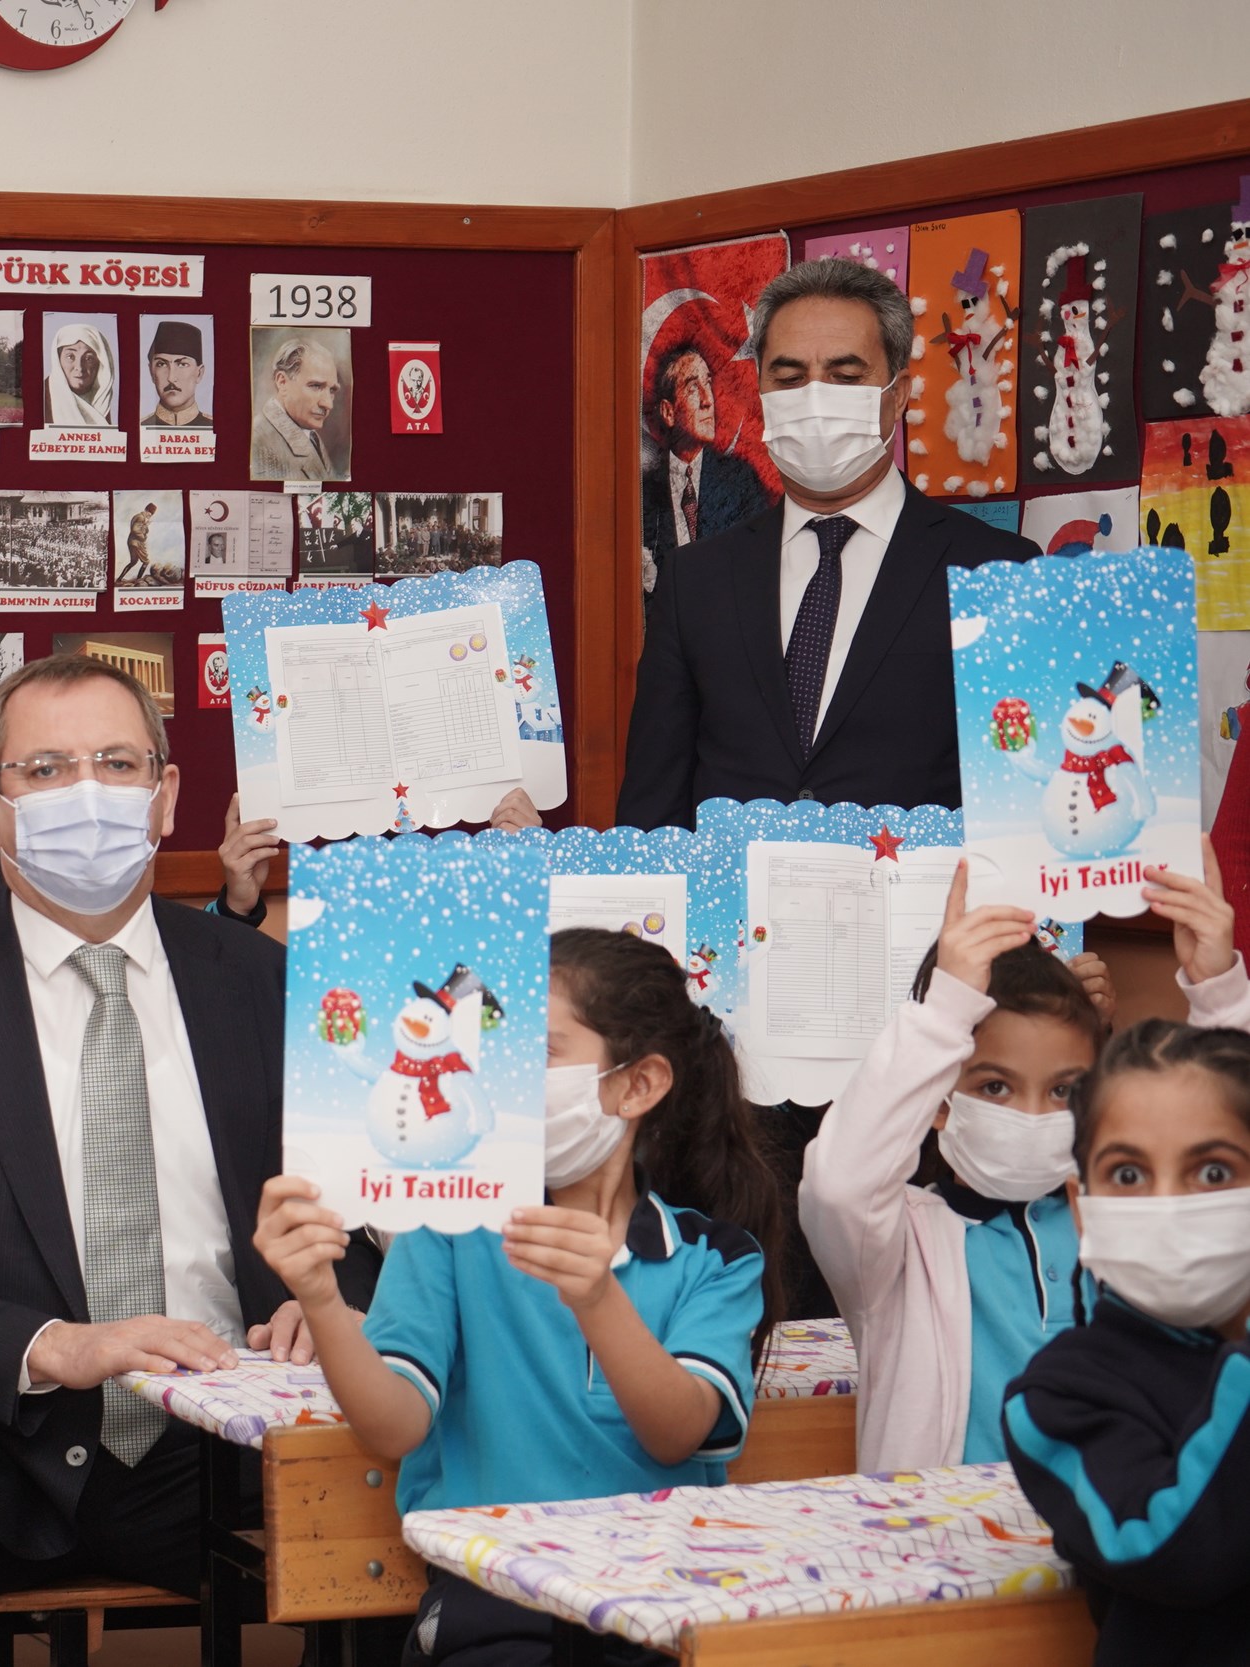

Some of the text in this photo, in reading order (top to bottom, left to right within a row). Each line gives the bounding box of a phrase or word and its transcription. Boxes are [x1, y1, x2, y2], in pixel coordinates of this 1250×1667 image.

[17, 8, 28, 28] 7
[83, 10, 95, 31] 5
[50, 18, 62, 39] 6
[79, 258, 190, 292] KÖŞESİ
[268, 284, 359, 319] 1938
[406, 422, 430, 431] ATA
[58, 432, 102, 442] ANNESİ
[159, 434, 200, 443] BABASI
[31, 442, 126, 454] ZÜBEYDE HANIM
[143, 445, 216, 455] ALİ RIZA BEY
[196, 580, 285, 591] NÜFUS CÜZDANI
[53, 598, 95, 608] AÇILIŞI
[119, 596, 180, 606] KOCATEPE
[1040, 860, 1168, 897] İyi Tatill
[360, 1169, 505, 1202] İyi Tatiller
